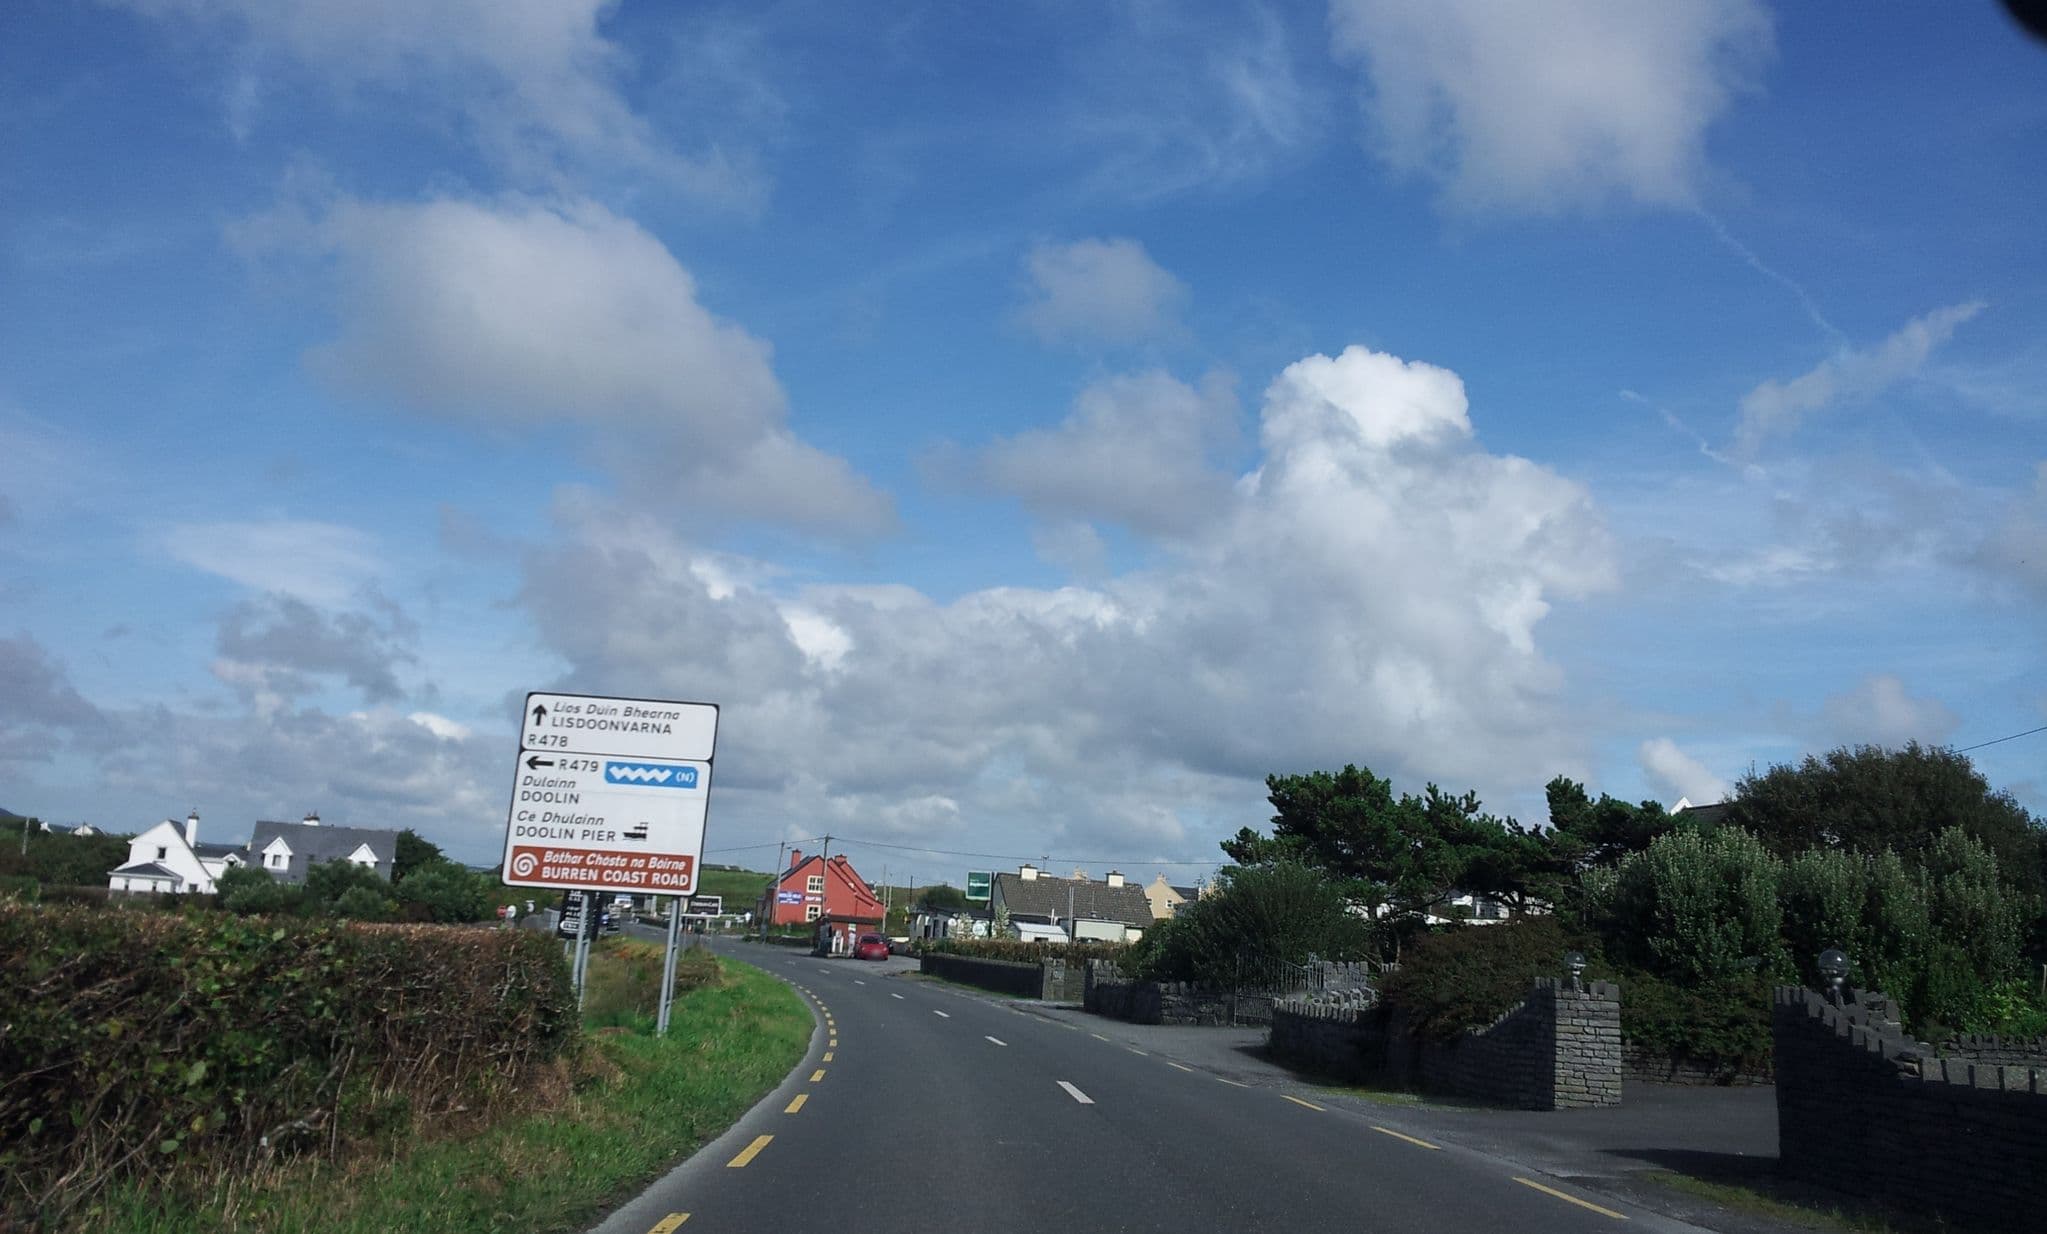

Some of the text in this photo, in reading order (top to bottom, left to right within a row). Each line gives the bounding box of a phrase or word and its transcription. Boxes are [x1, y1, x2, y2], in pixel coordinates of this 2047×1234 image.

[623, 706, 681, 720] Bhearna
[551, 717, 672, 734] LISDOONVARNA
[527, 734, 568, 747] R478
[559, 759, 599, 772] R479
[521, 790, 580, 804] DOOLIN
[516, 826, 616, 842] DOOLIN PIER
[541, 866, 689, 886] BURREN COAST ROAD
